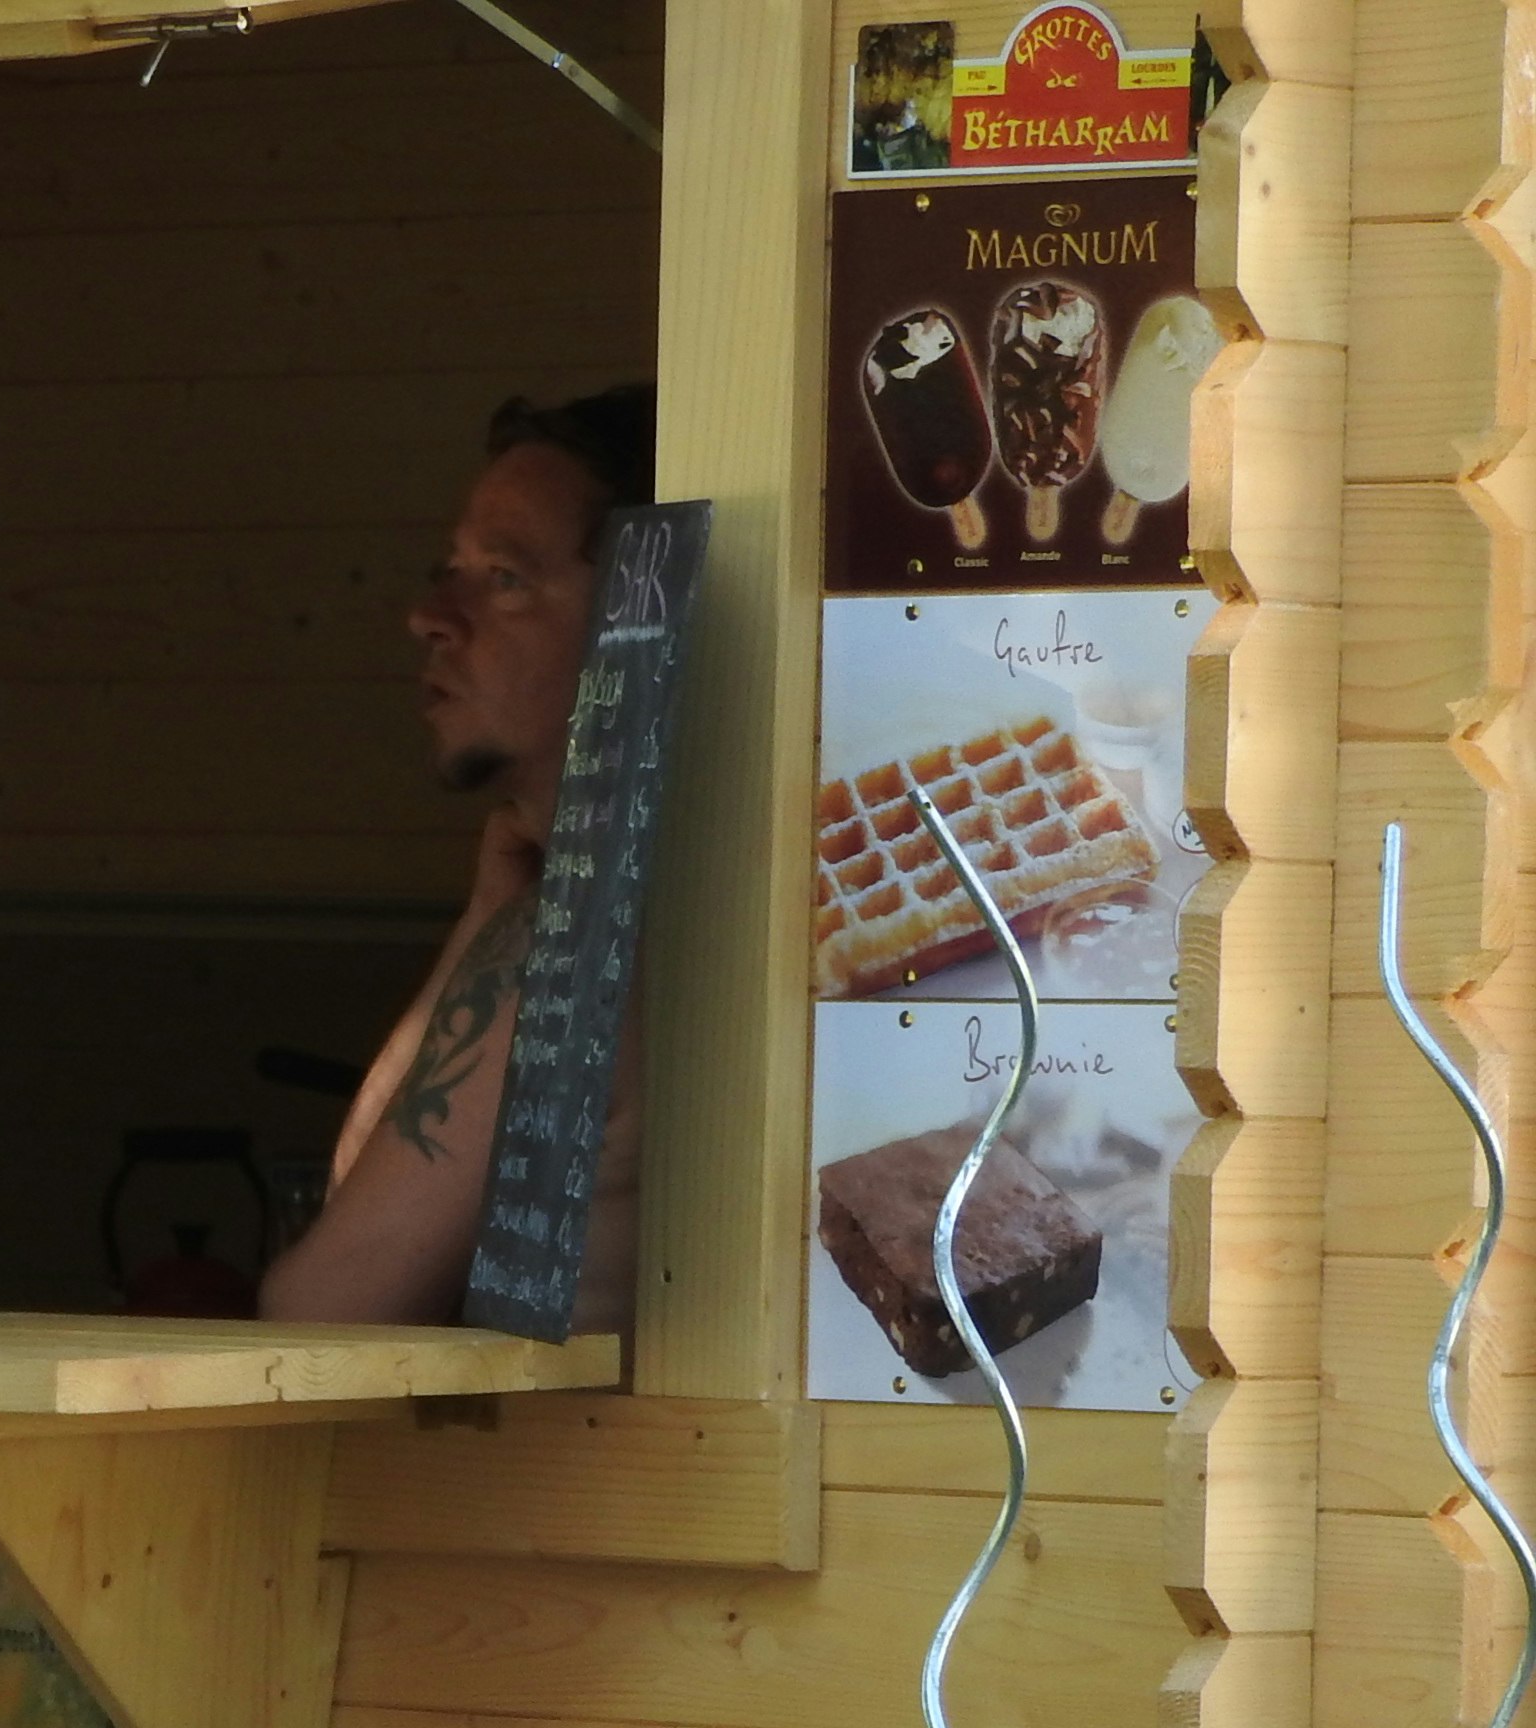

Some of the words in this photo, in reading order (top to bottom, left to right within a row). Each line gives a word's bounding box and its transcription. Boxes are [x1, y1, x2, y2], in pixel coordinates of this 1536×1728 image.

[1014, 16, 1112, 69] GROTTES
[1046, 69, 1077, 88] de
[1131, 62, 1176, 75] LOURDES
[962, 110, 1170, 156] BÉTHARRAM
[966, 220, 1157, 270] MAGNUM
[954, 556, 989, 568] Classic
[1020, 551, 1061, 561] Amande
[1102, 554, 1130, 565] Blanc
[994, 610, 1103, 677] Gaufre
